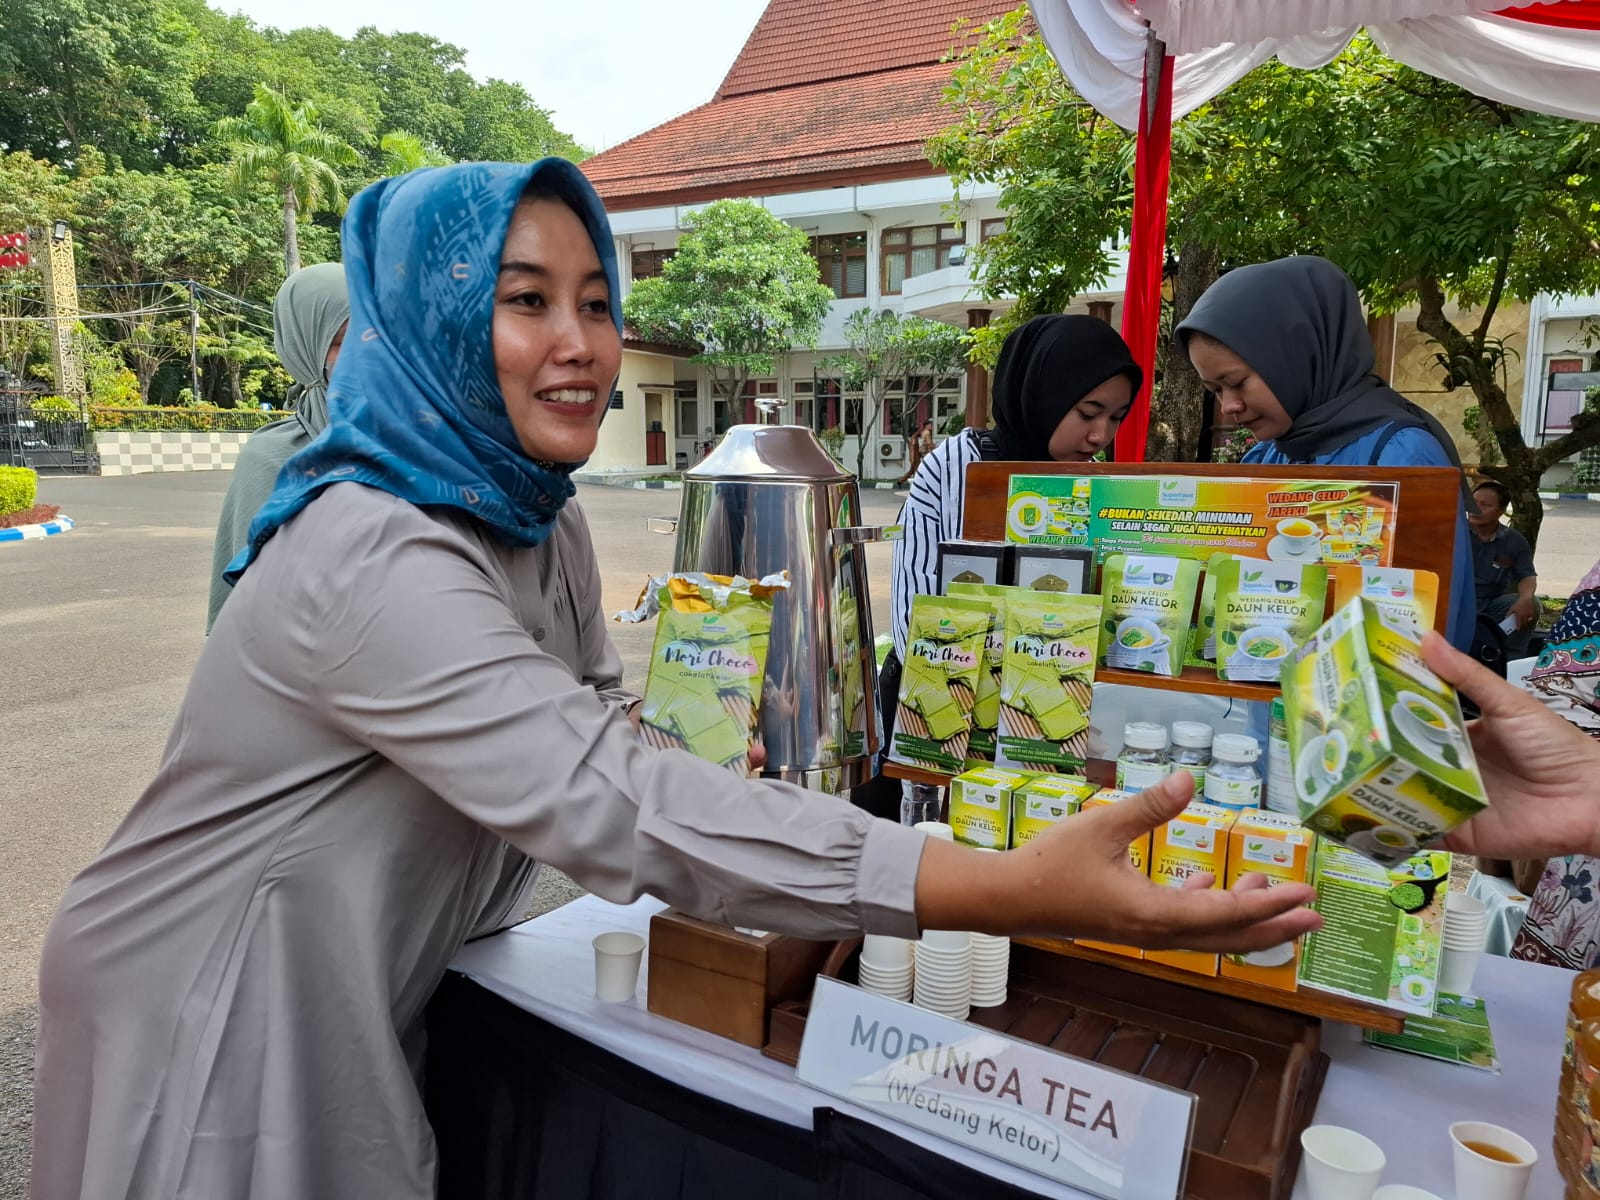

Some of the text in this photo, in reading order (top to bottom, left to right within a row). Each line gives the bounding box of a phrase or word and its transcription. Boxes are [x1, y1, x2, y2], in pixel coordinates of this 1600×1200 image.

[1267, 490, 1348, 504] WEDANG CELUP
[1098, 508, 1253, 524] #BUKAN SEKEDAR MINUMAN
[1268, 506, 1309, 518] JAREKU
[1111, 521, 1267, 537] SELAIN SEGAR JUGA MENYEHATKAN
[1028, 535, 1062, 544] WEDANG
[1111, 594, 1178, 609] DAUN KELOR
[1226, 603, 1307, 617] DAUN KELOR
[912, 641, 973, 664] Mori Choco
[1014, 640, 1088, 659] Mori Choco
[664, 647, 755, 669] Mori Choco
[1352, 788, 1438, 832] DAUN KELOR
[955, 816, 977, 827] DAUN
[978, 822, 1002, 834] KELOR
[1160, 857, 1215, 873] WEDANG CELUP
[849, 1014, 1120, 1140] MORINGA TEA
[887, 1075, 1063, 1163] (Wedang Kelor)
